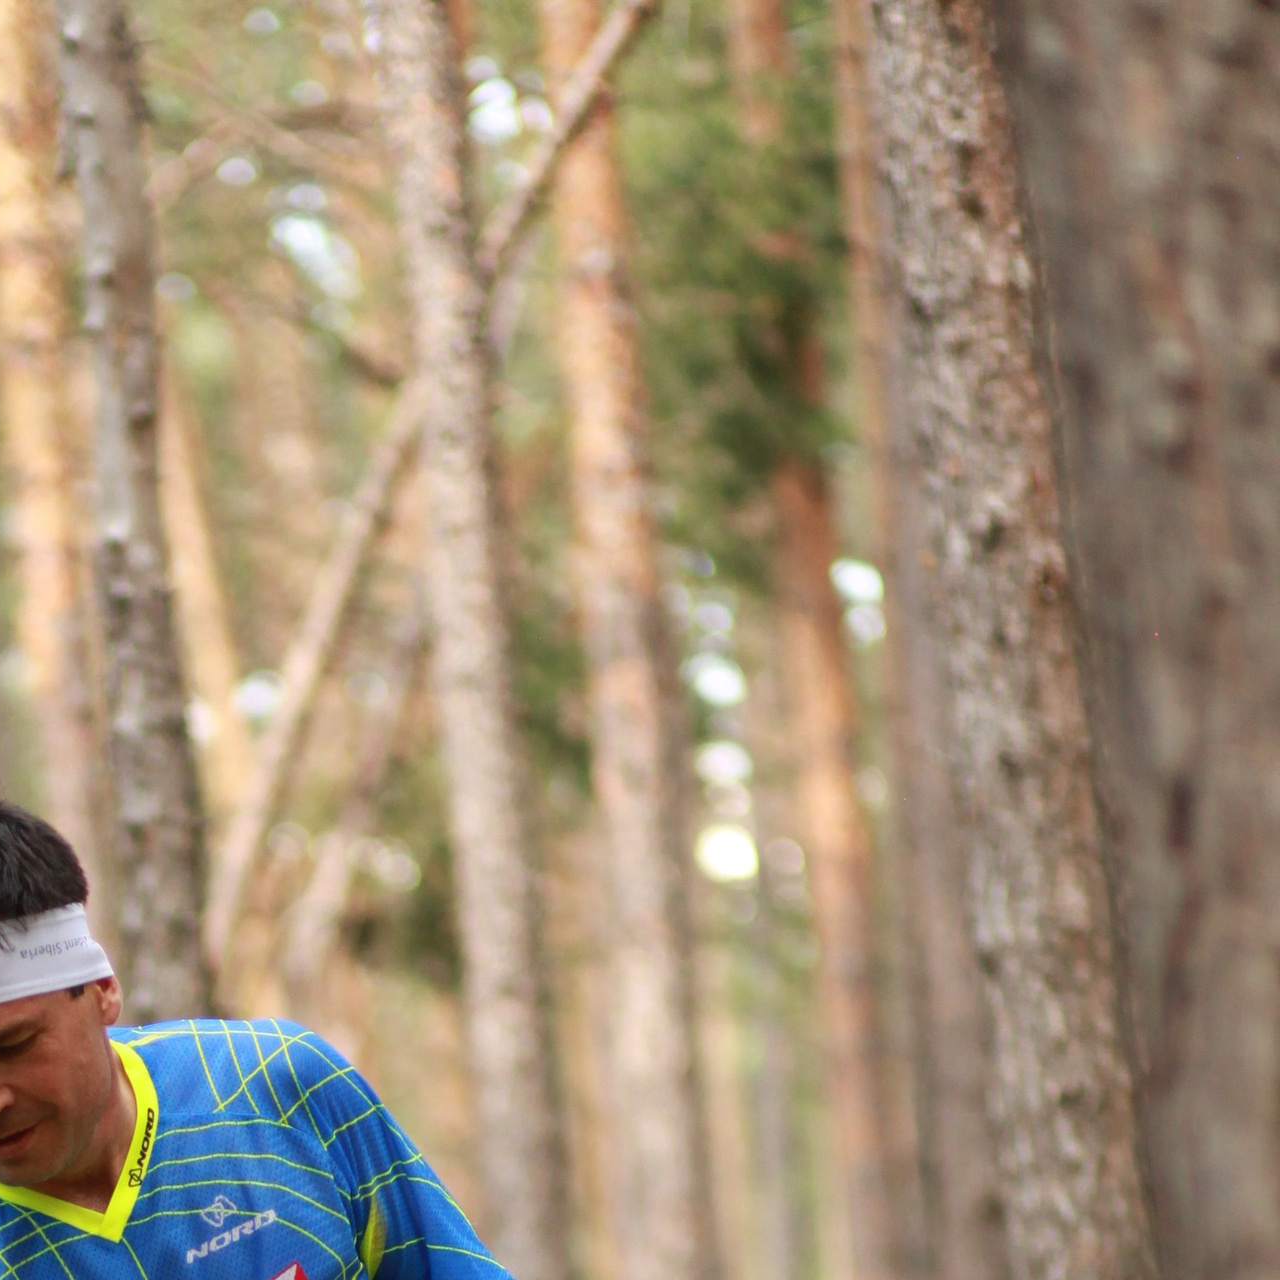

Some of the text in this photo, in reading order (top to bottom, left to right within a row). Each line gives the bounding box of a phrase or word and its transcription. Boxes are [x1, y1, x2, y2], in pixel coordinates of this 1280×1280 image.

[20, 942, 63, 960] Siberia
[137, 1108, 155, 1168] NORD
[186, 1209, 277, 1264] NORD
